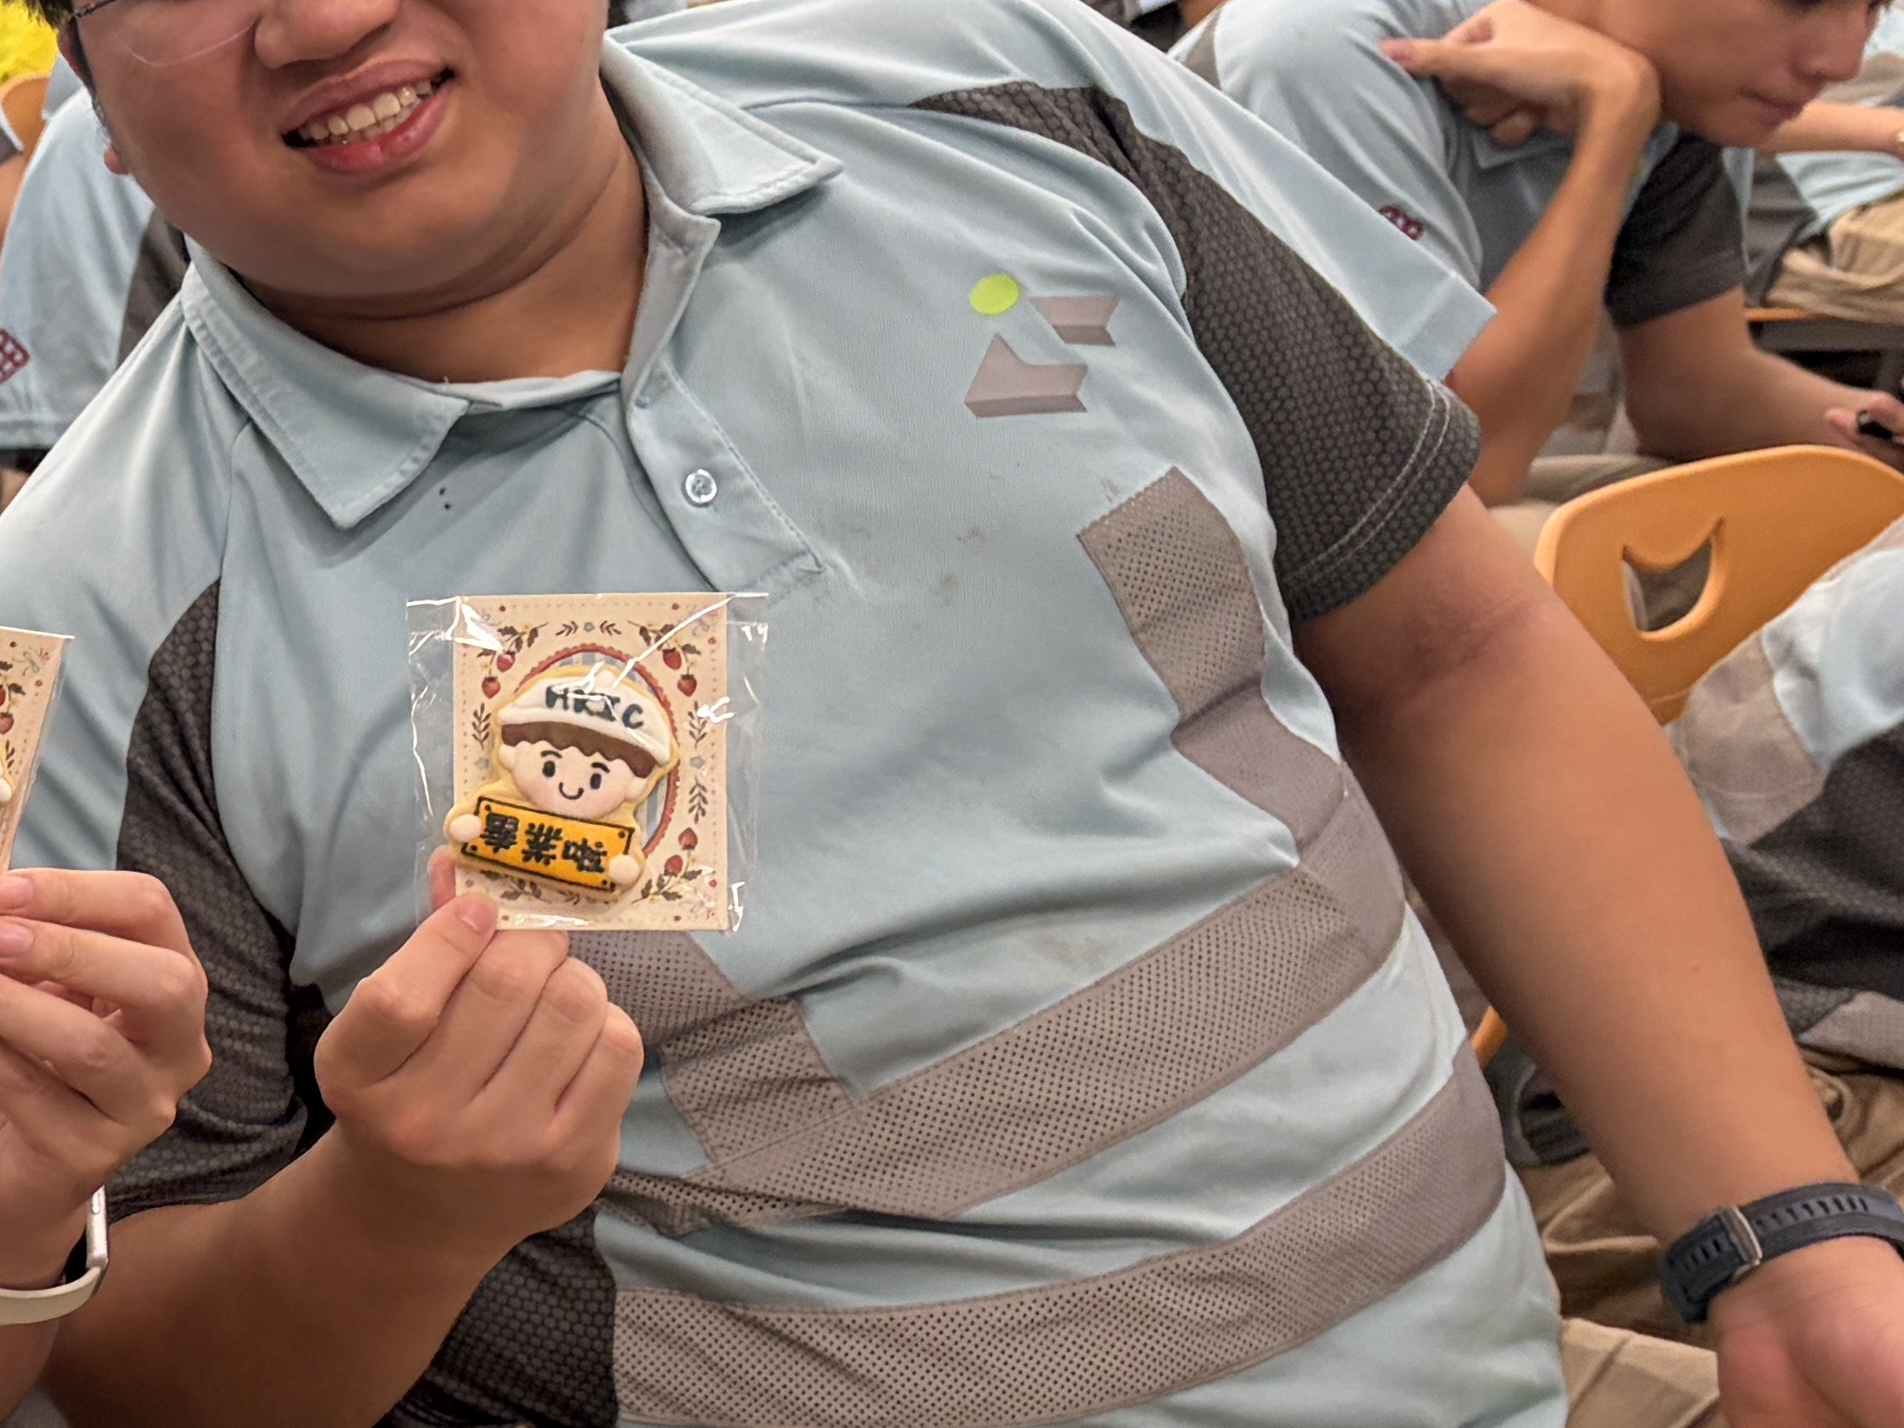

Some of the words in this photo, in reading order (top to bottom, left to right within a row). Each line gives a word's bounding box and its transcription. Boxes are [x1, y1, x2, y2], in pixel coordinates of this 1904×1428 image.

[546, 685, 644, 730] HKIC
[479, 812, 608, 873] 畢業啦
